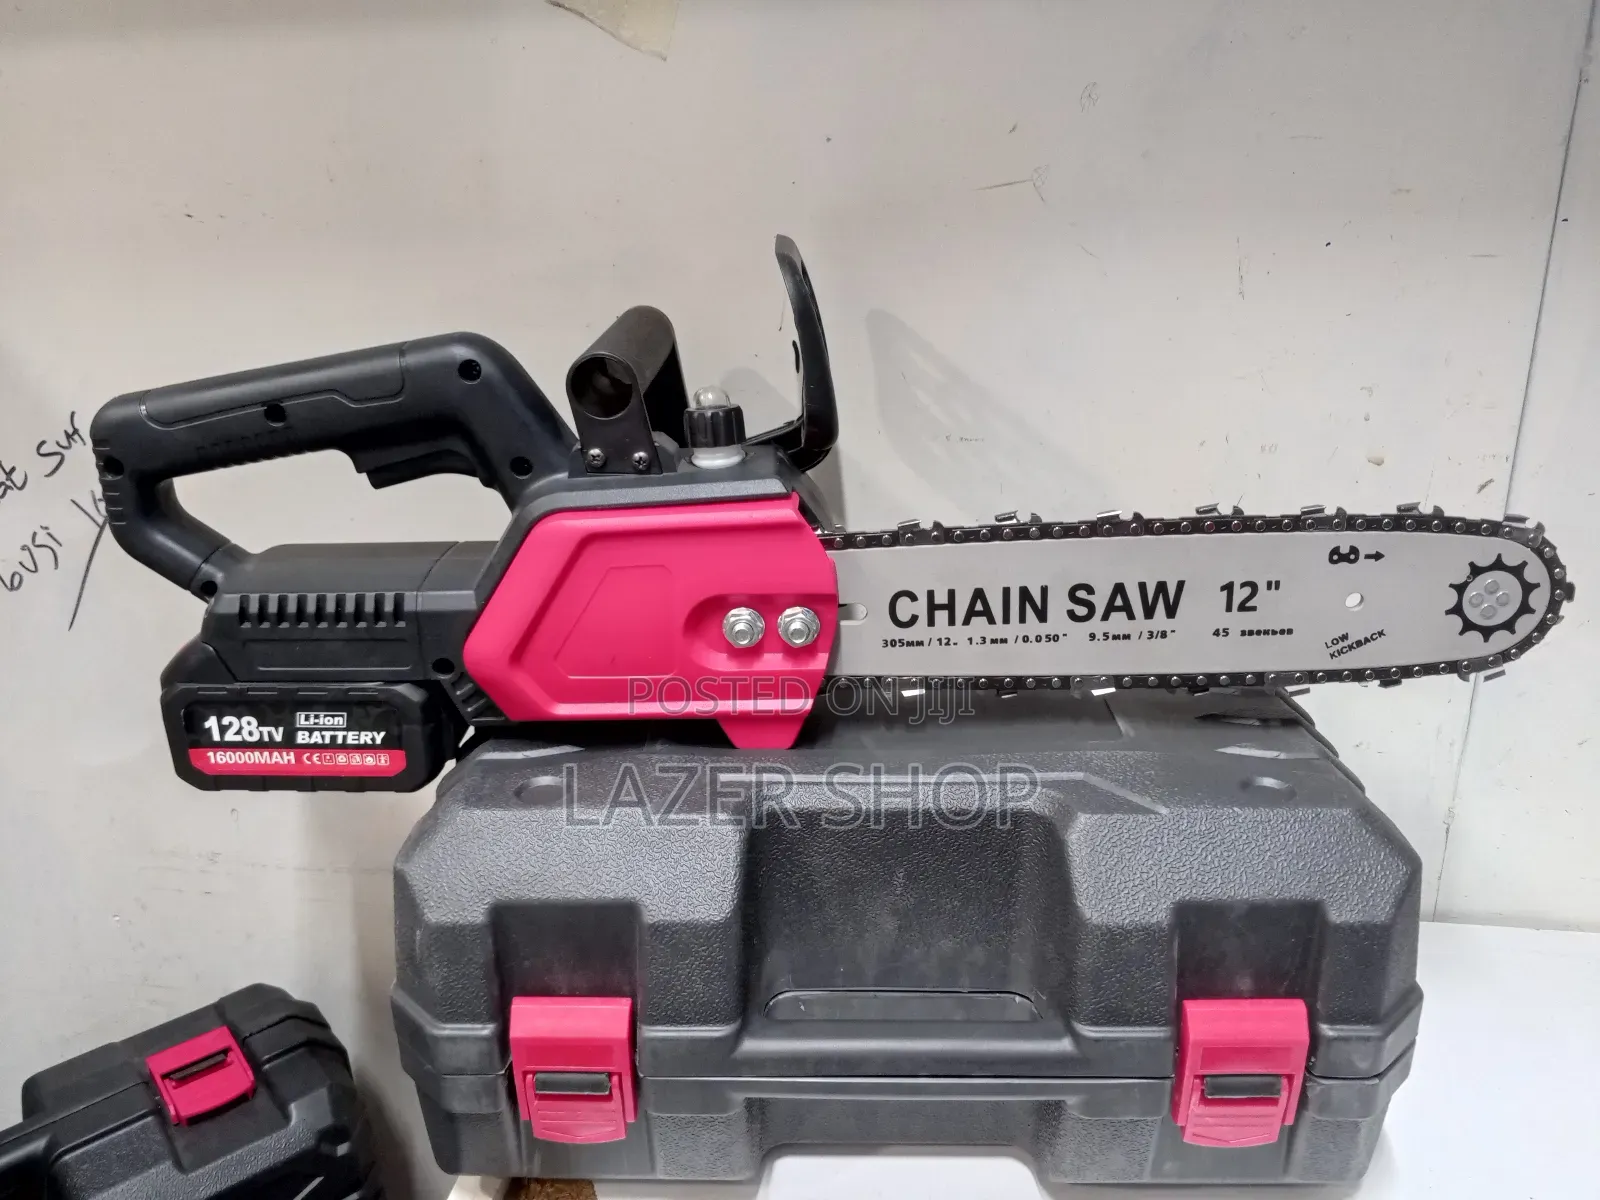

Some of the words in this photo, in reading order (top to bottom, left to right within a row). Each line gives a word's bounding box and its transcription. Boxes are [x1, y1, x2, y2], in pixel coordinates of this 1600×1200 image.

[888, 585, 1049, 629] CHAIN
[1066, 580, 1186, 623] SAW
[1220, 580, 1281, 613] 12"
[1212, 628, 1230, 637] 45
[1325, 632, 1349, 649] LOW
[1329, 629, 1386, 660] KICKBACK
[299, 713, 344, 726] Li-ion
[203, 715, 284, 742] 128TV
[296, 731, 386, 745] BATTERY
[206, 751, 296, 765] 16000MAH
